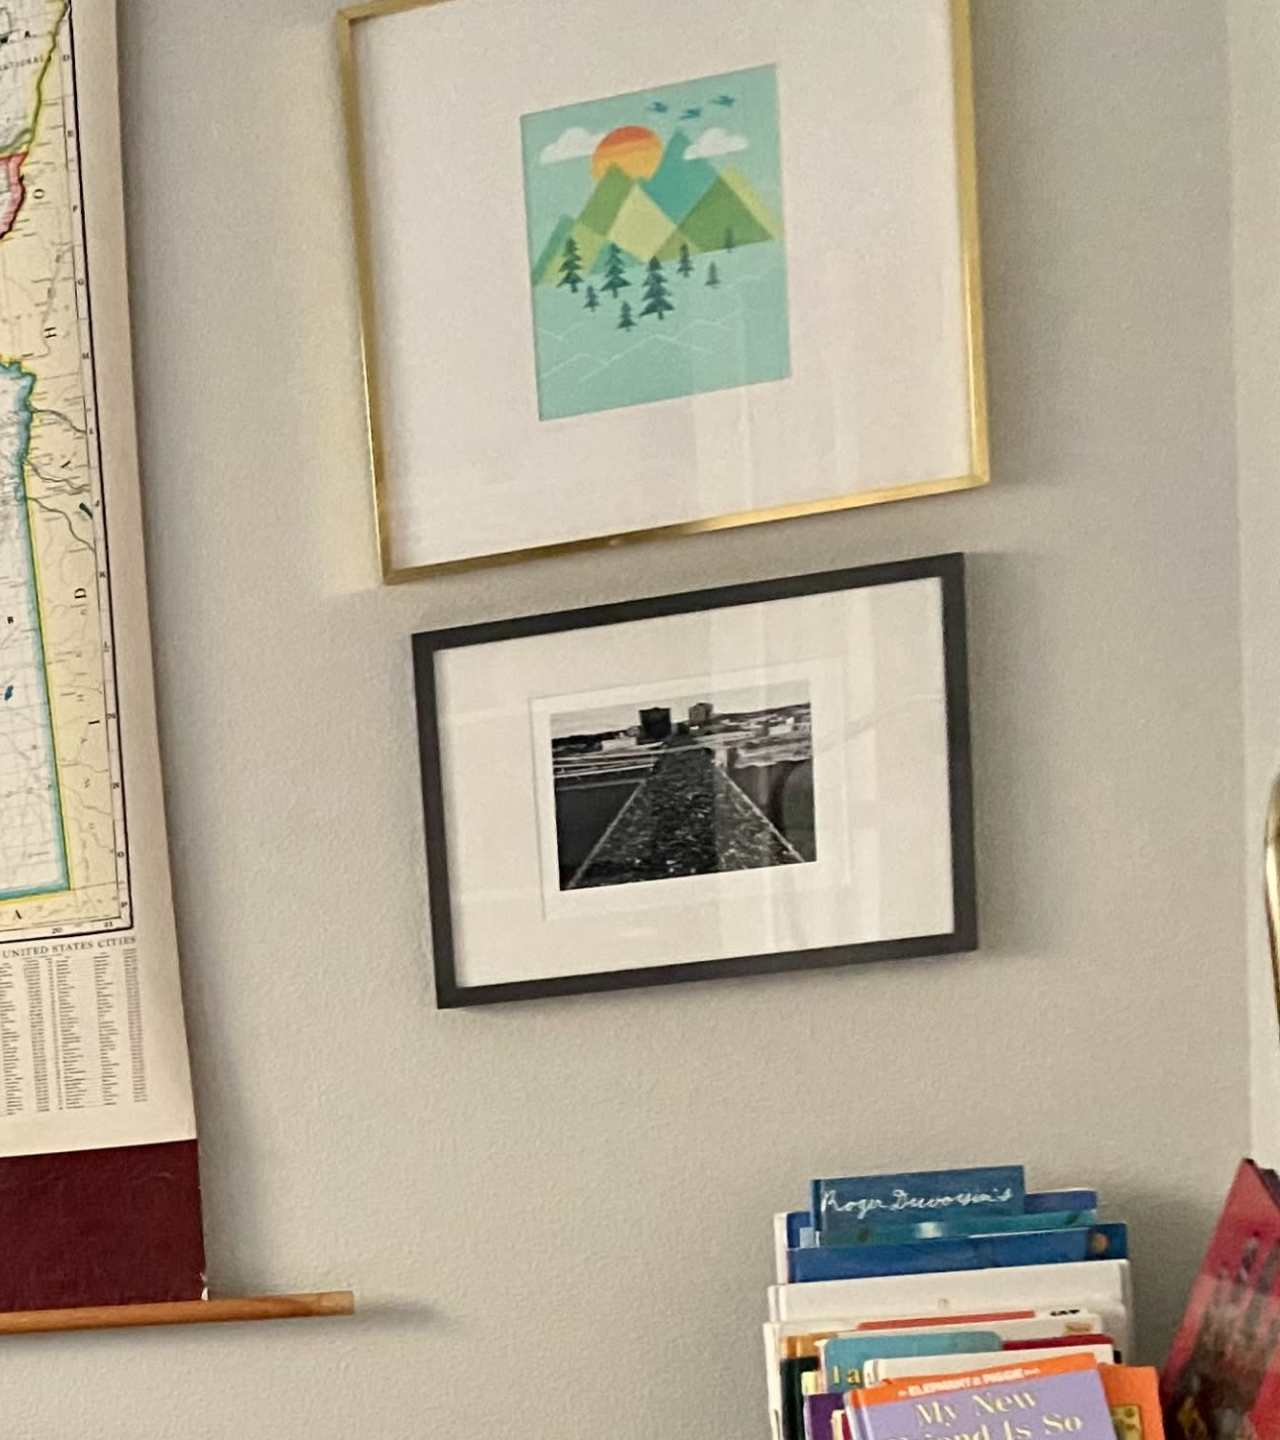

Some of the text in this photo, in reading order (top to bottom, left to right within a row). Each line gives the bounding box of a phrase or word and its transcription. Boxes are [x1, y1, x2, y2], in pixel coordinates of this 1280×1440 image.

[2, 945, 49, 958] UNITED
[52, 941, 94, 954] STATES
[97, 935, 137, 949] CITIES
[914, 1390, 1038, 1428] My New
[1041, 1411, 1085, 1436] So
